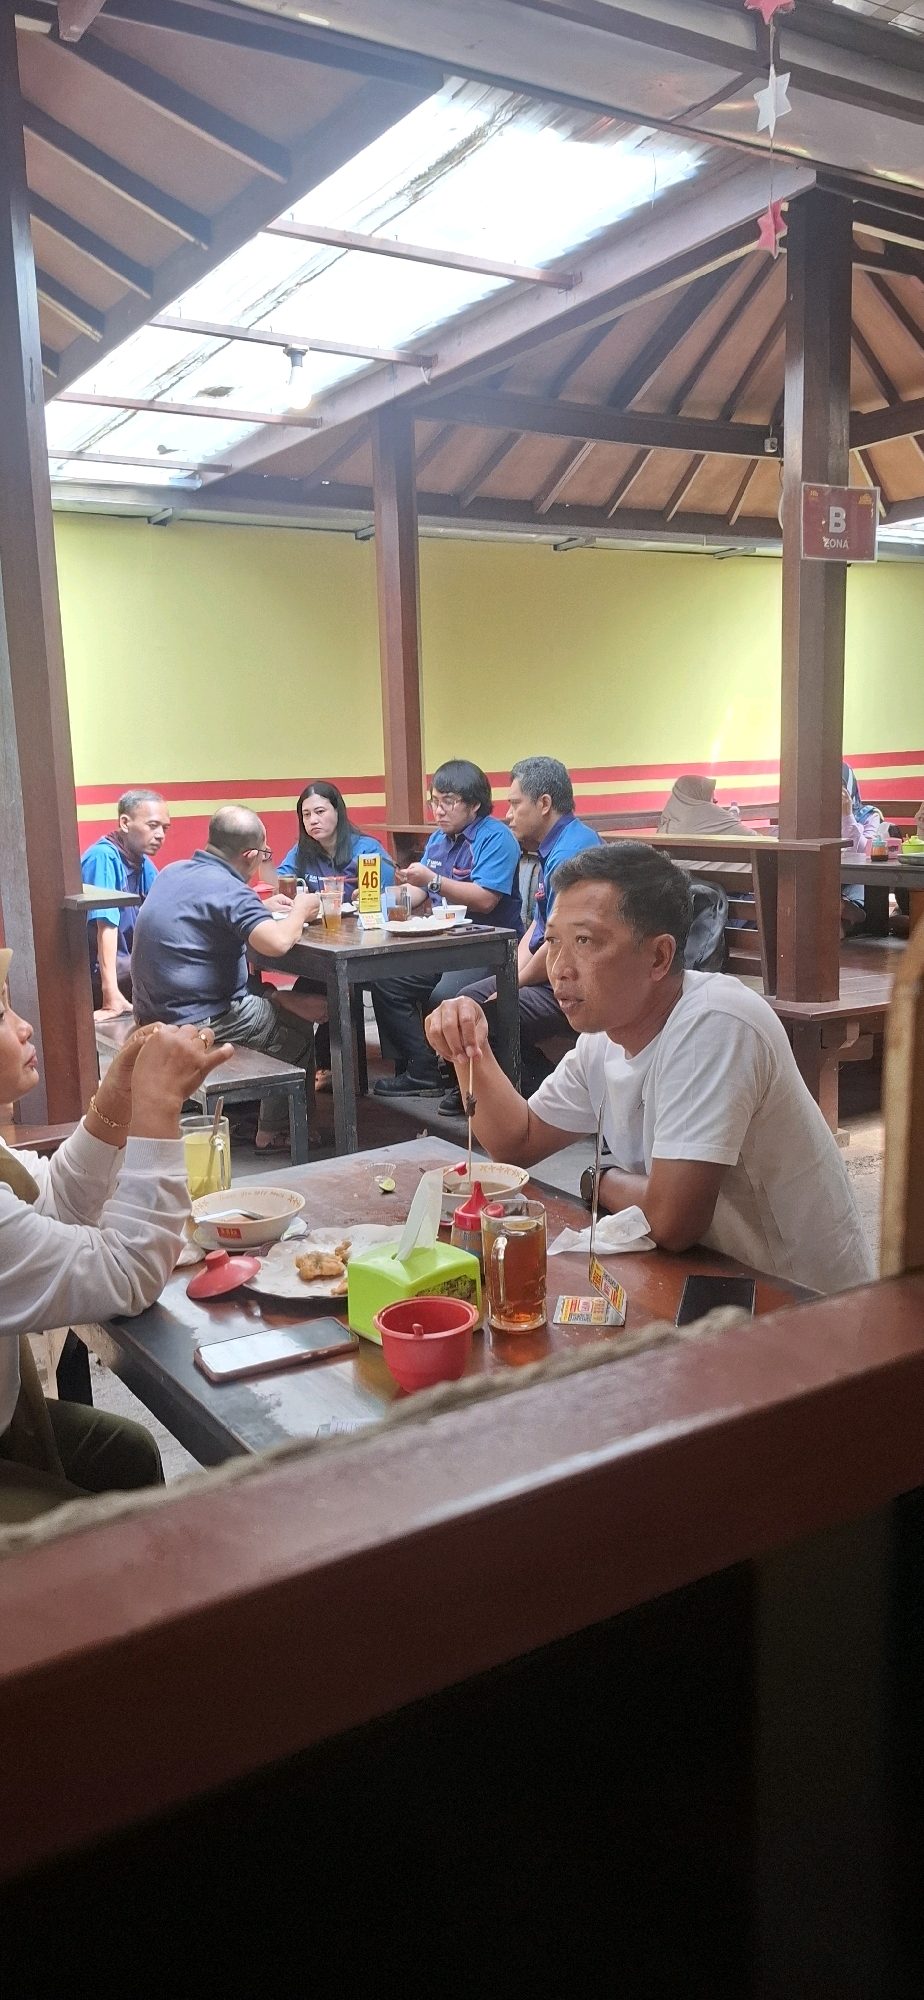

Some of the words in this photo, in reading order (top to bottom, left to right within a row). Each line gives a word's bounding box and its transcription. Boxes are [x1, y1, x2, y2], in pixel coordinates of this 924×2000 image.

[829, 506, 846, 533] B
[824, 538, 849, 549] ZONA
[361, 870, 379, 889] 46
